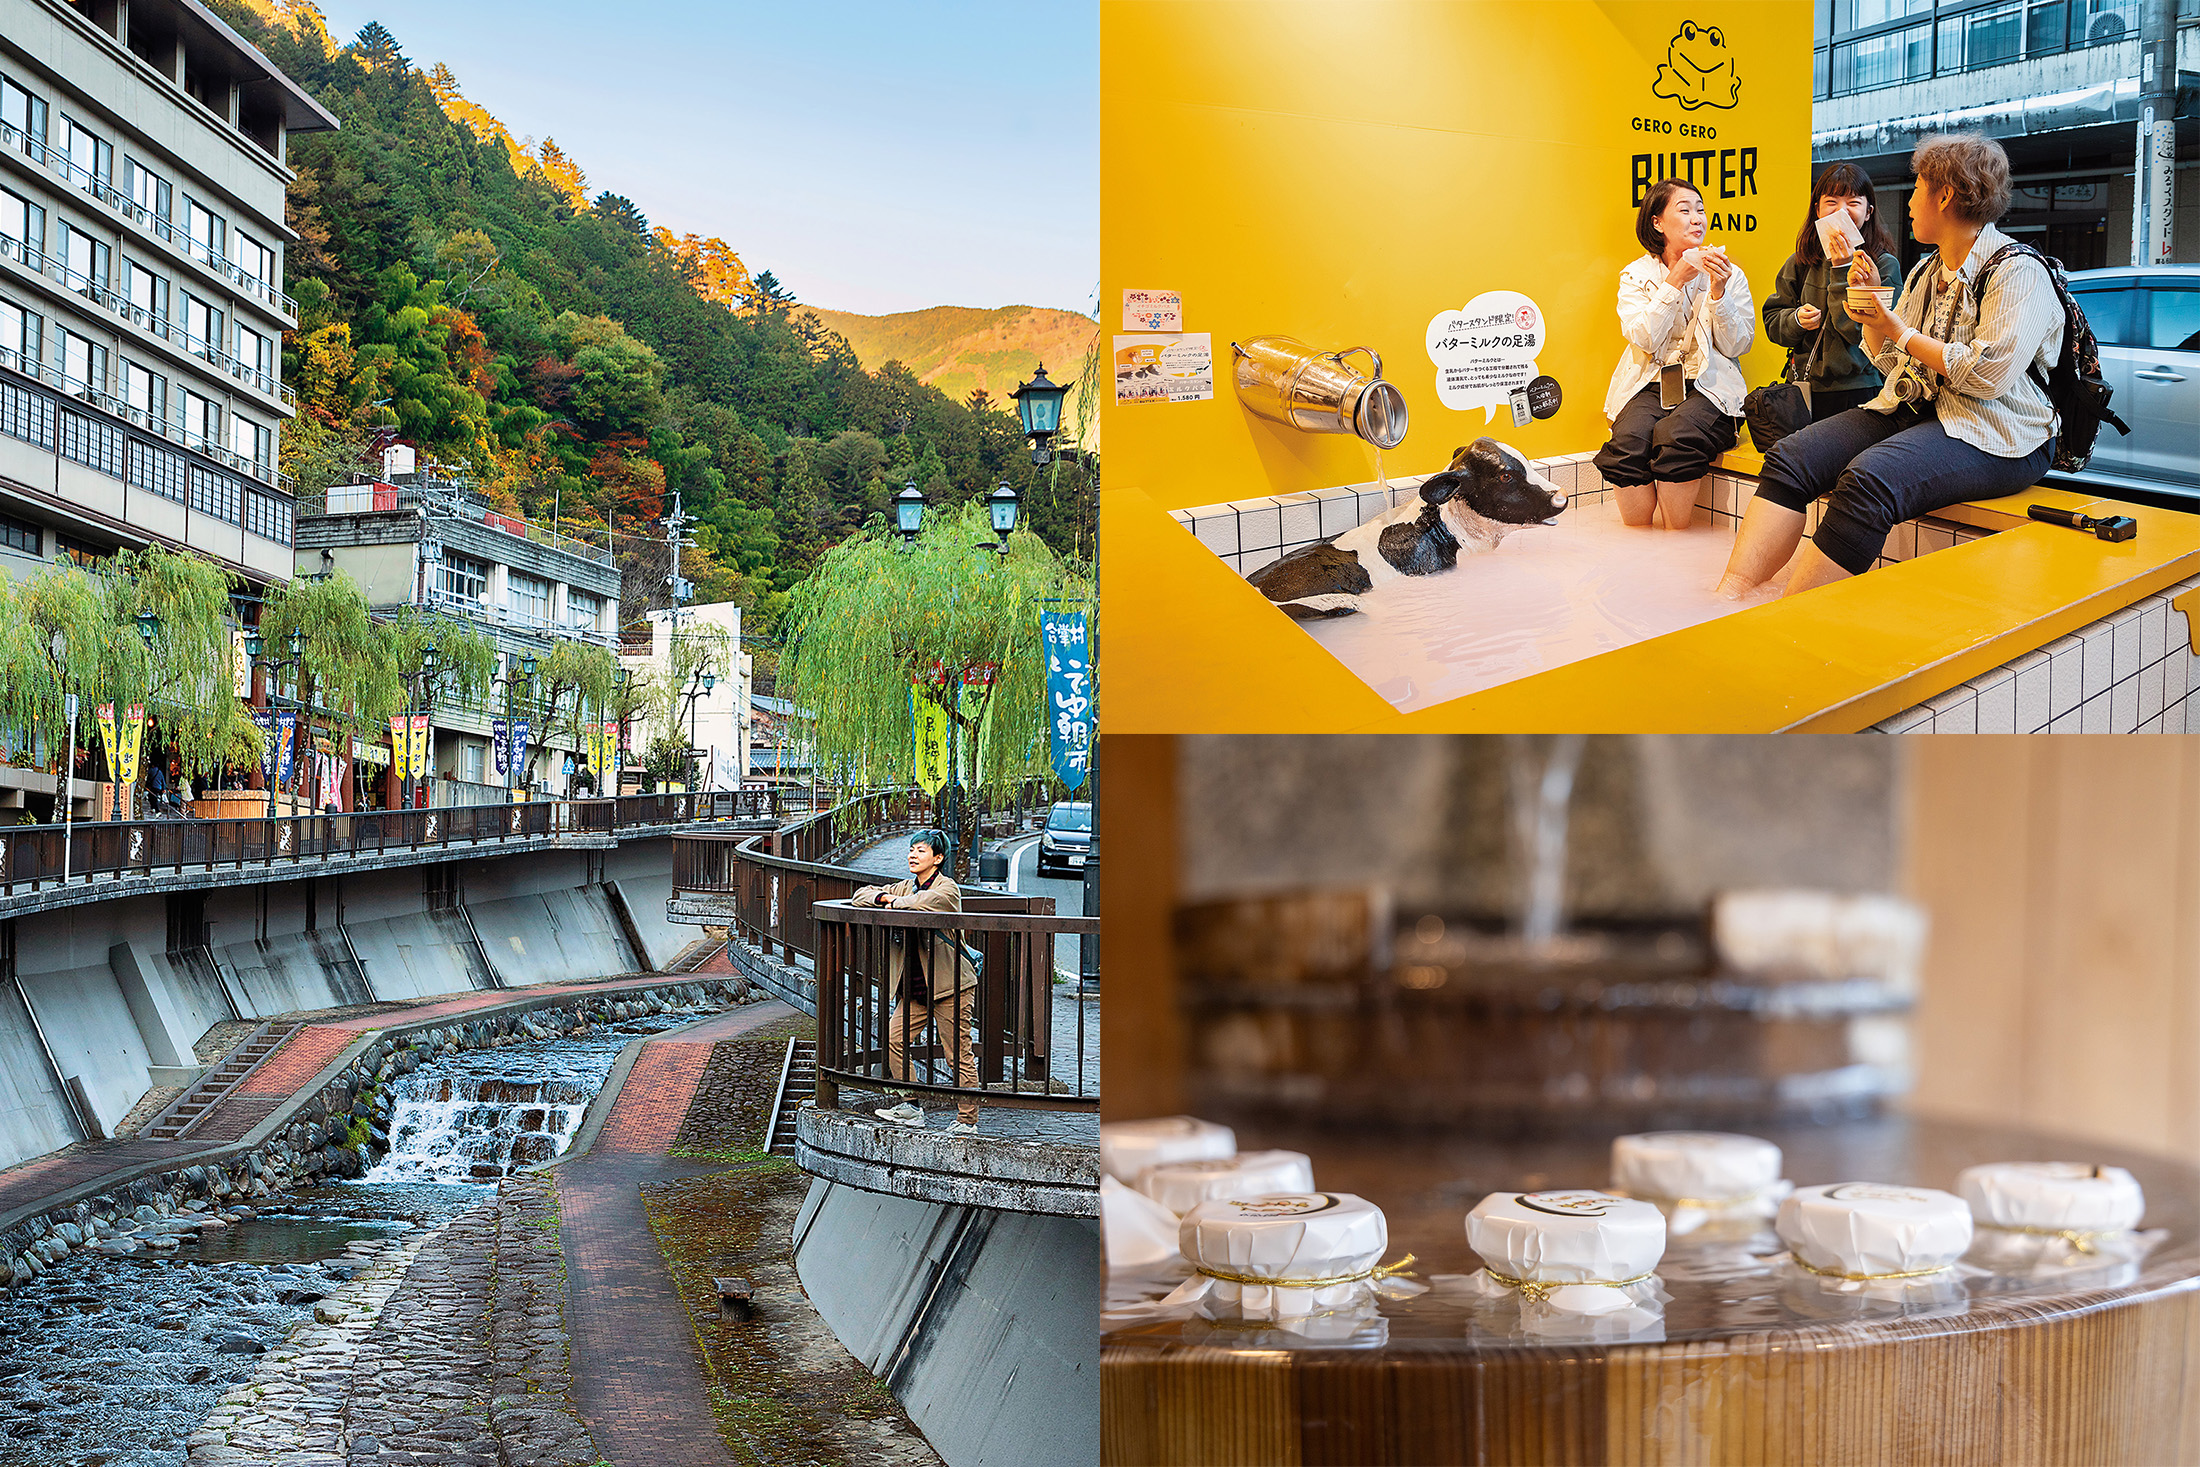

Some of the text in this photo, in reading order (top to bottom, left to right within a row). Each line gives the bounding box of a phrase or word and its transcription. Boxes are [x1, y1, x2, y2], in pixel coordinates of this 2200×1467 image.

[1631, 117, 1717, 140] GERO GERO
[1435, 333, 1536, 350] バターミルクの足湯
